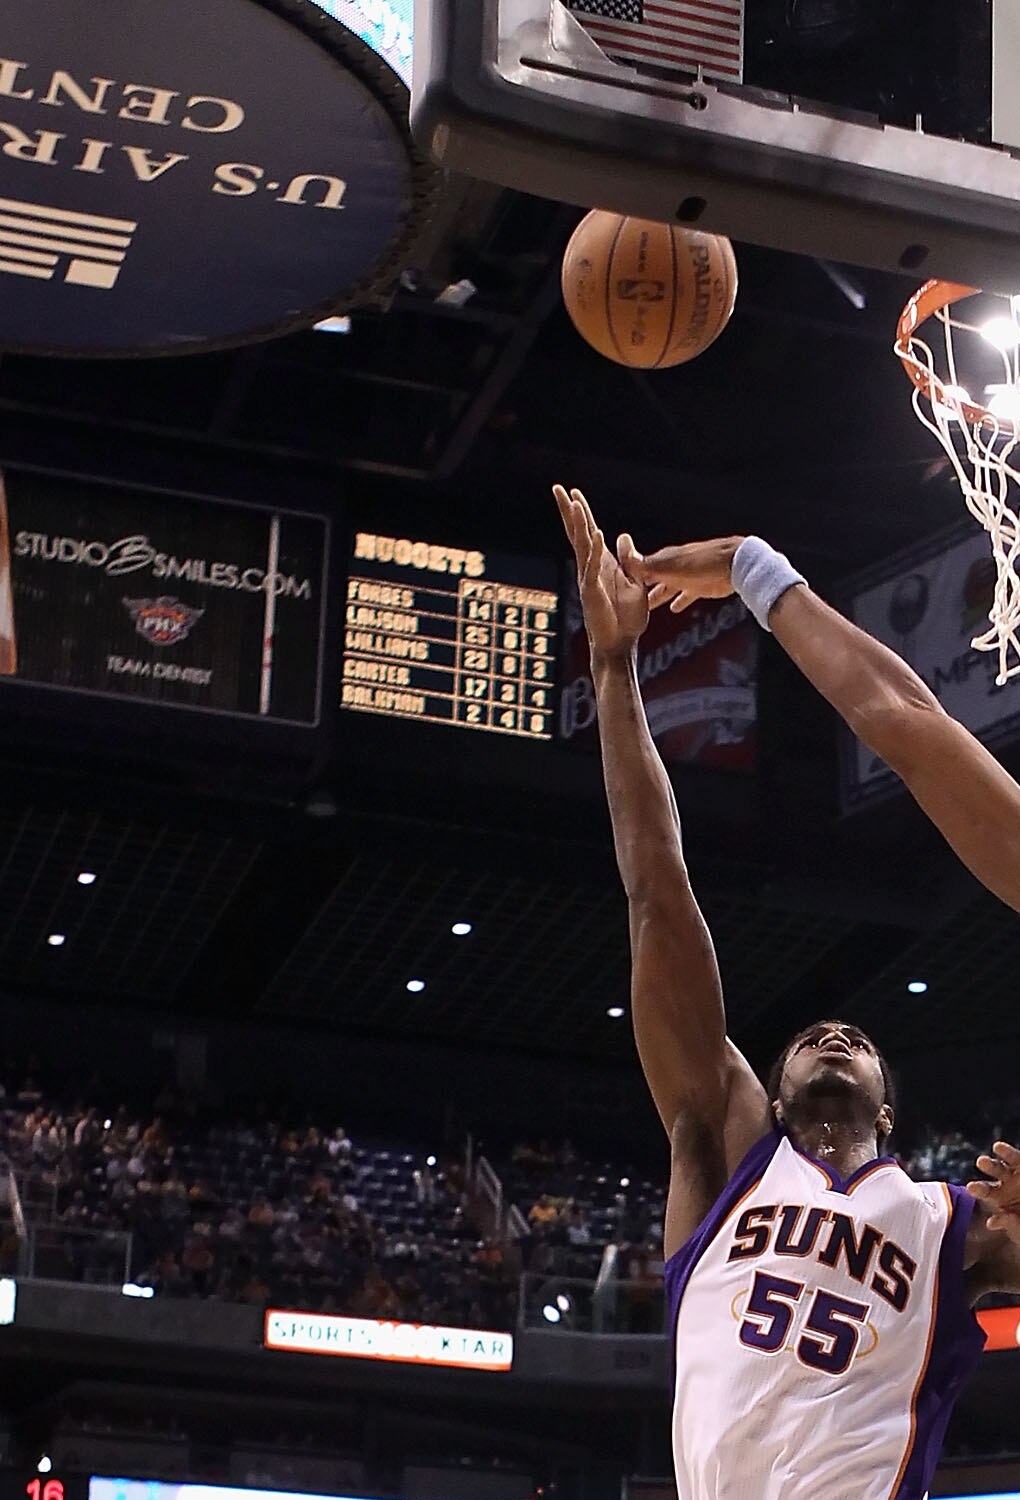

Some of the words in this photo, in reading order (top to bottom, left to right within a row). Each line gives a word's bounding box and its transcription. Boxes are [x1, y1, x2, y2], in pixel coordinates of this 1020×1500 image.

[468, 601, 490, 621] 14
[505, 607, 519, 625] 2
[465, 625, 490, 645] 25
[464, 677, 487, 697] 17
[466, 704, 481, 723] 2
[500, 710, 515, 728] 4
[727, 1203, 917, 1313] SUNS
[274, 1321, 373, 1346] SPORTS
[738, 1269, 870, 1376] 55
